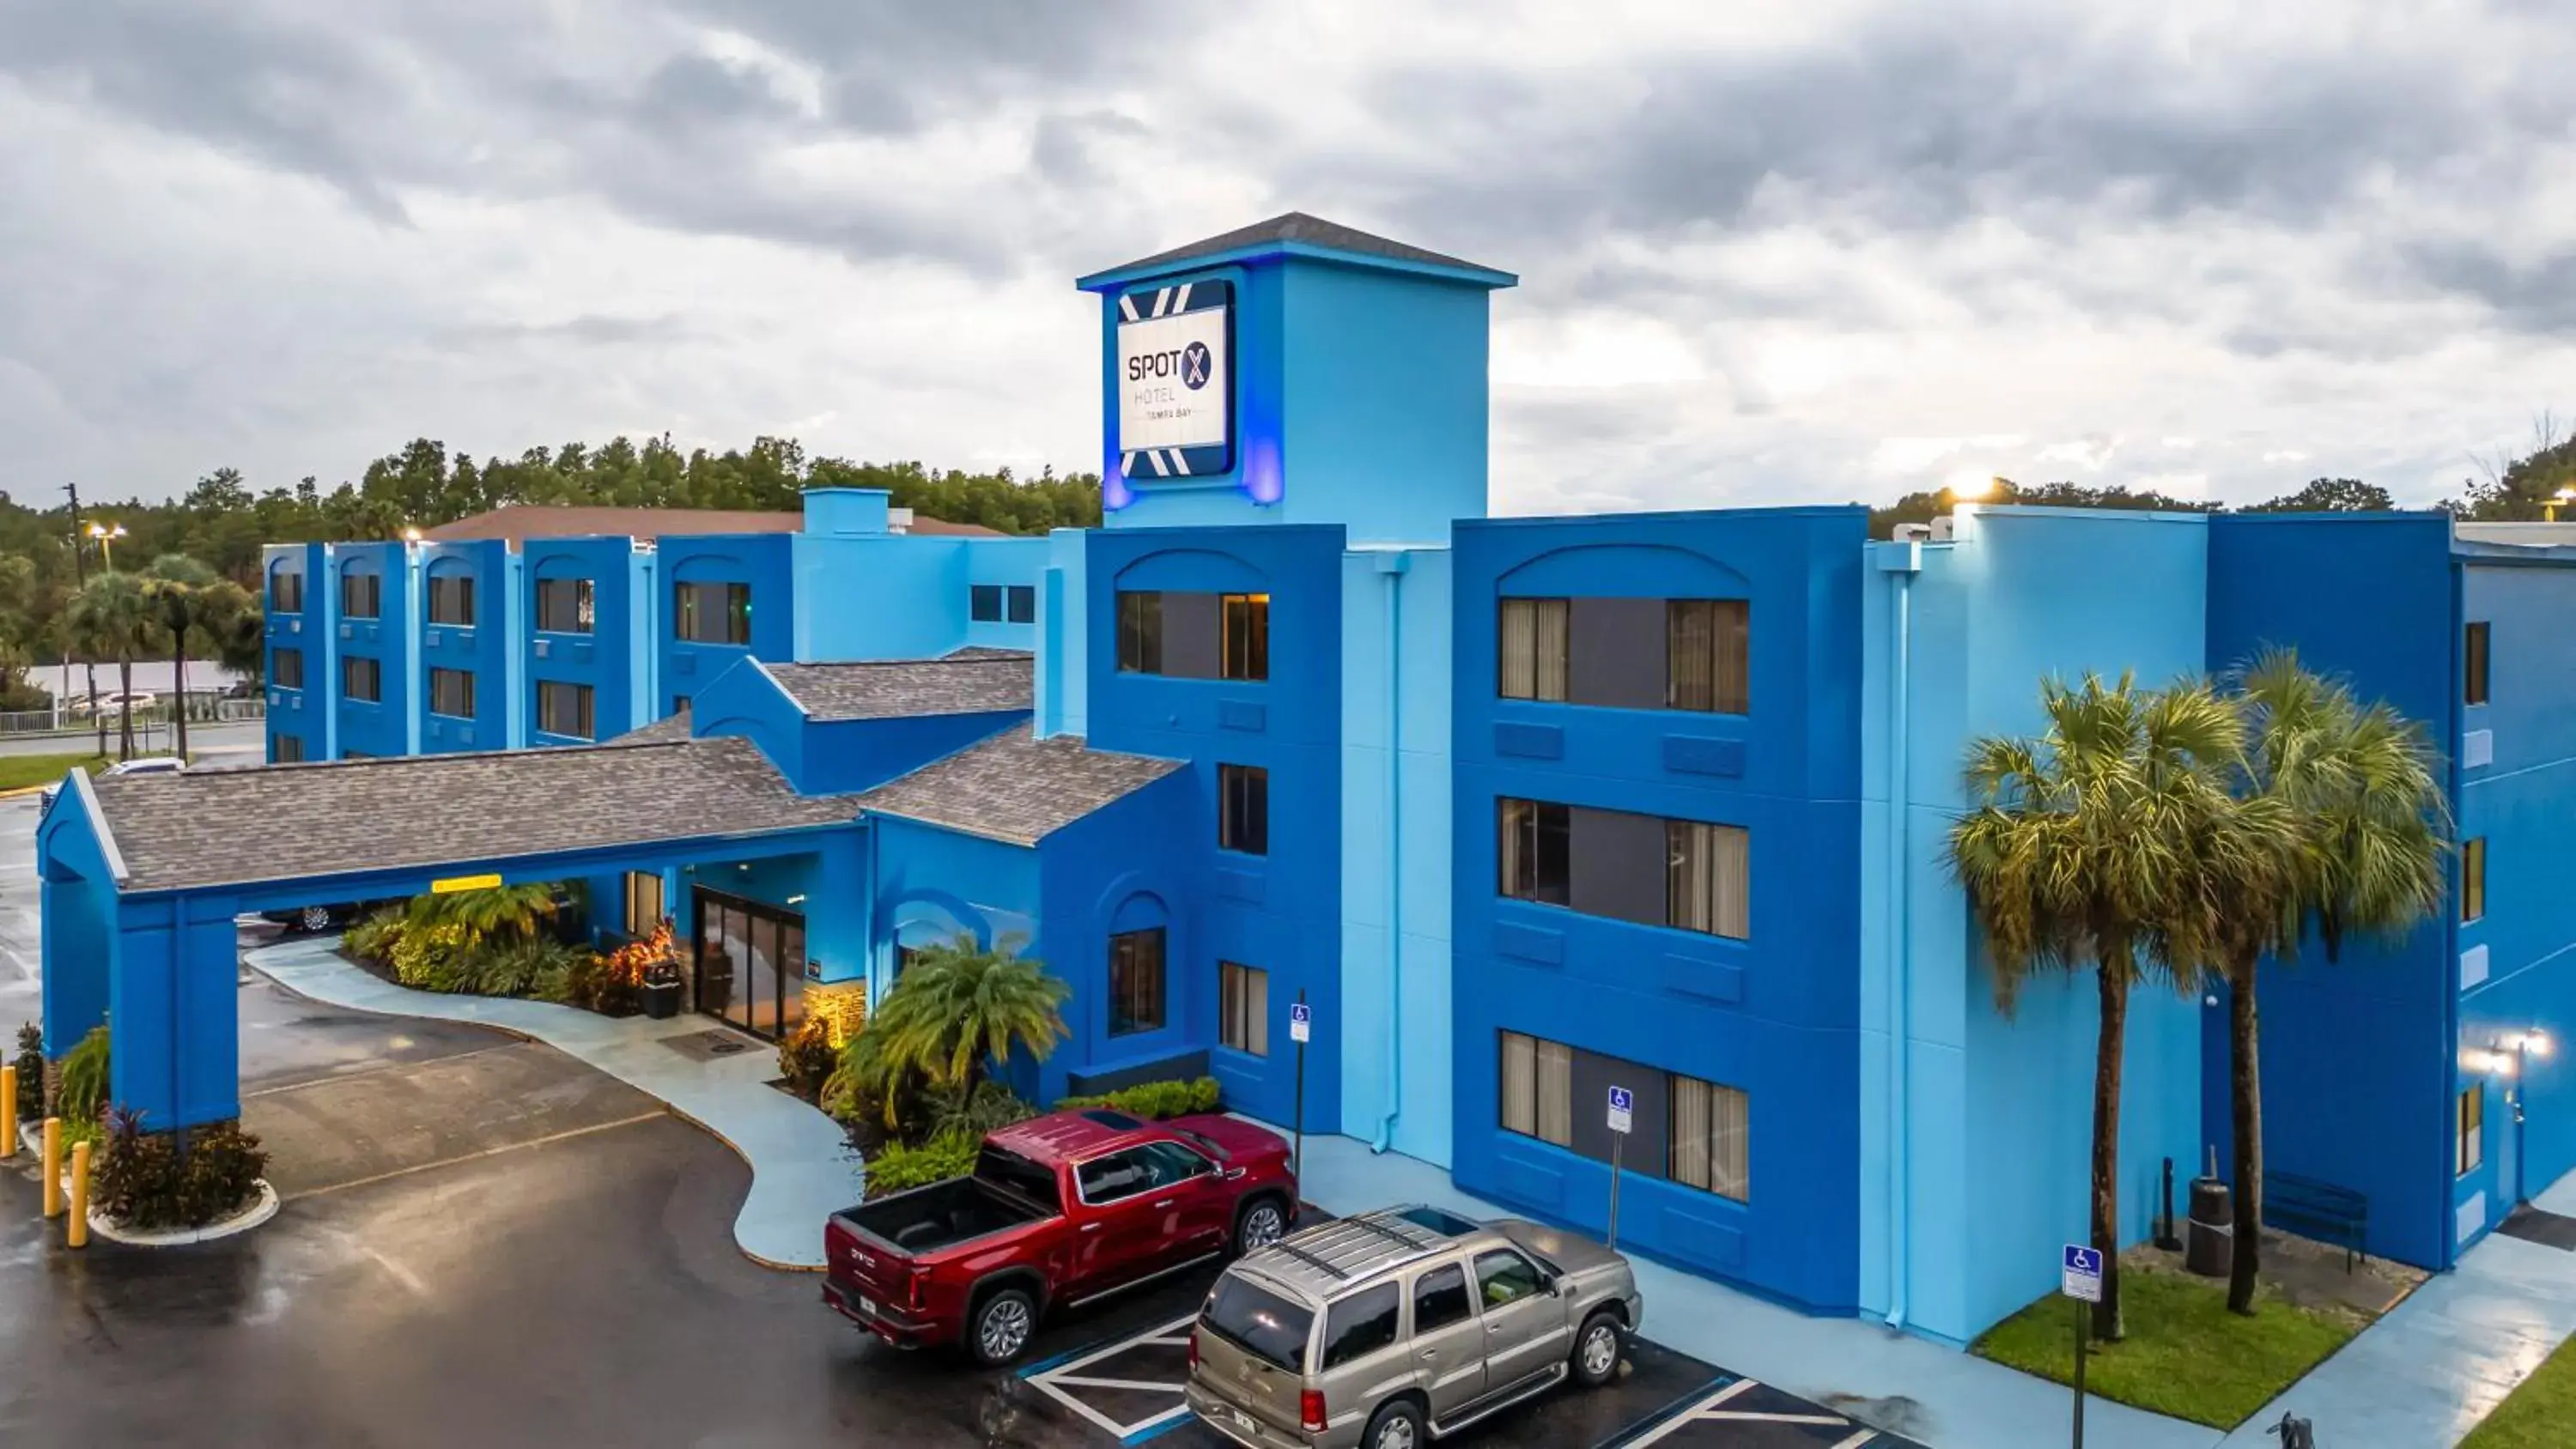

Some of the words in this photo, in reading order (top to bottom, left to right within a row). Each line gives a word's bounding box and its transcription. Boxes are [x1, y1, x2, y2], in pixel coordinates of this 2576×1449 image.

[1129, 350, 1182, 381] SPOT
[1187, 348, 1205, 383] X
[1134, 387, 1176, 406] HOTEL
[1176, 406, 1192, 418] BAY
